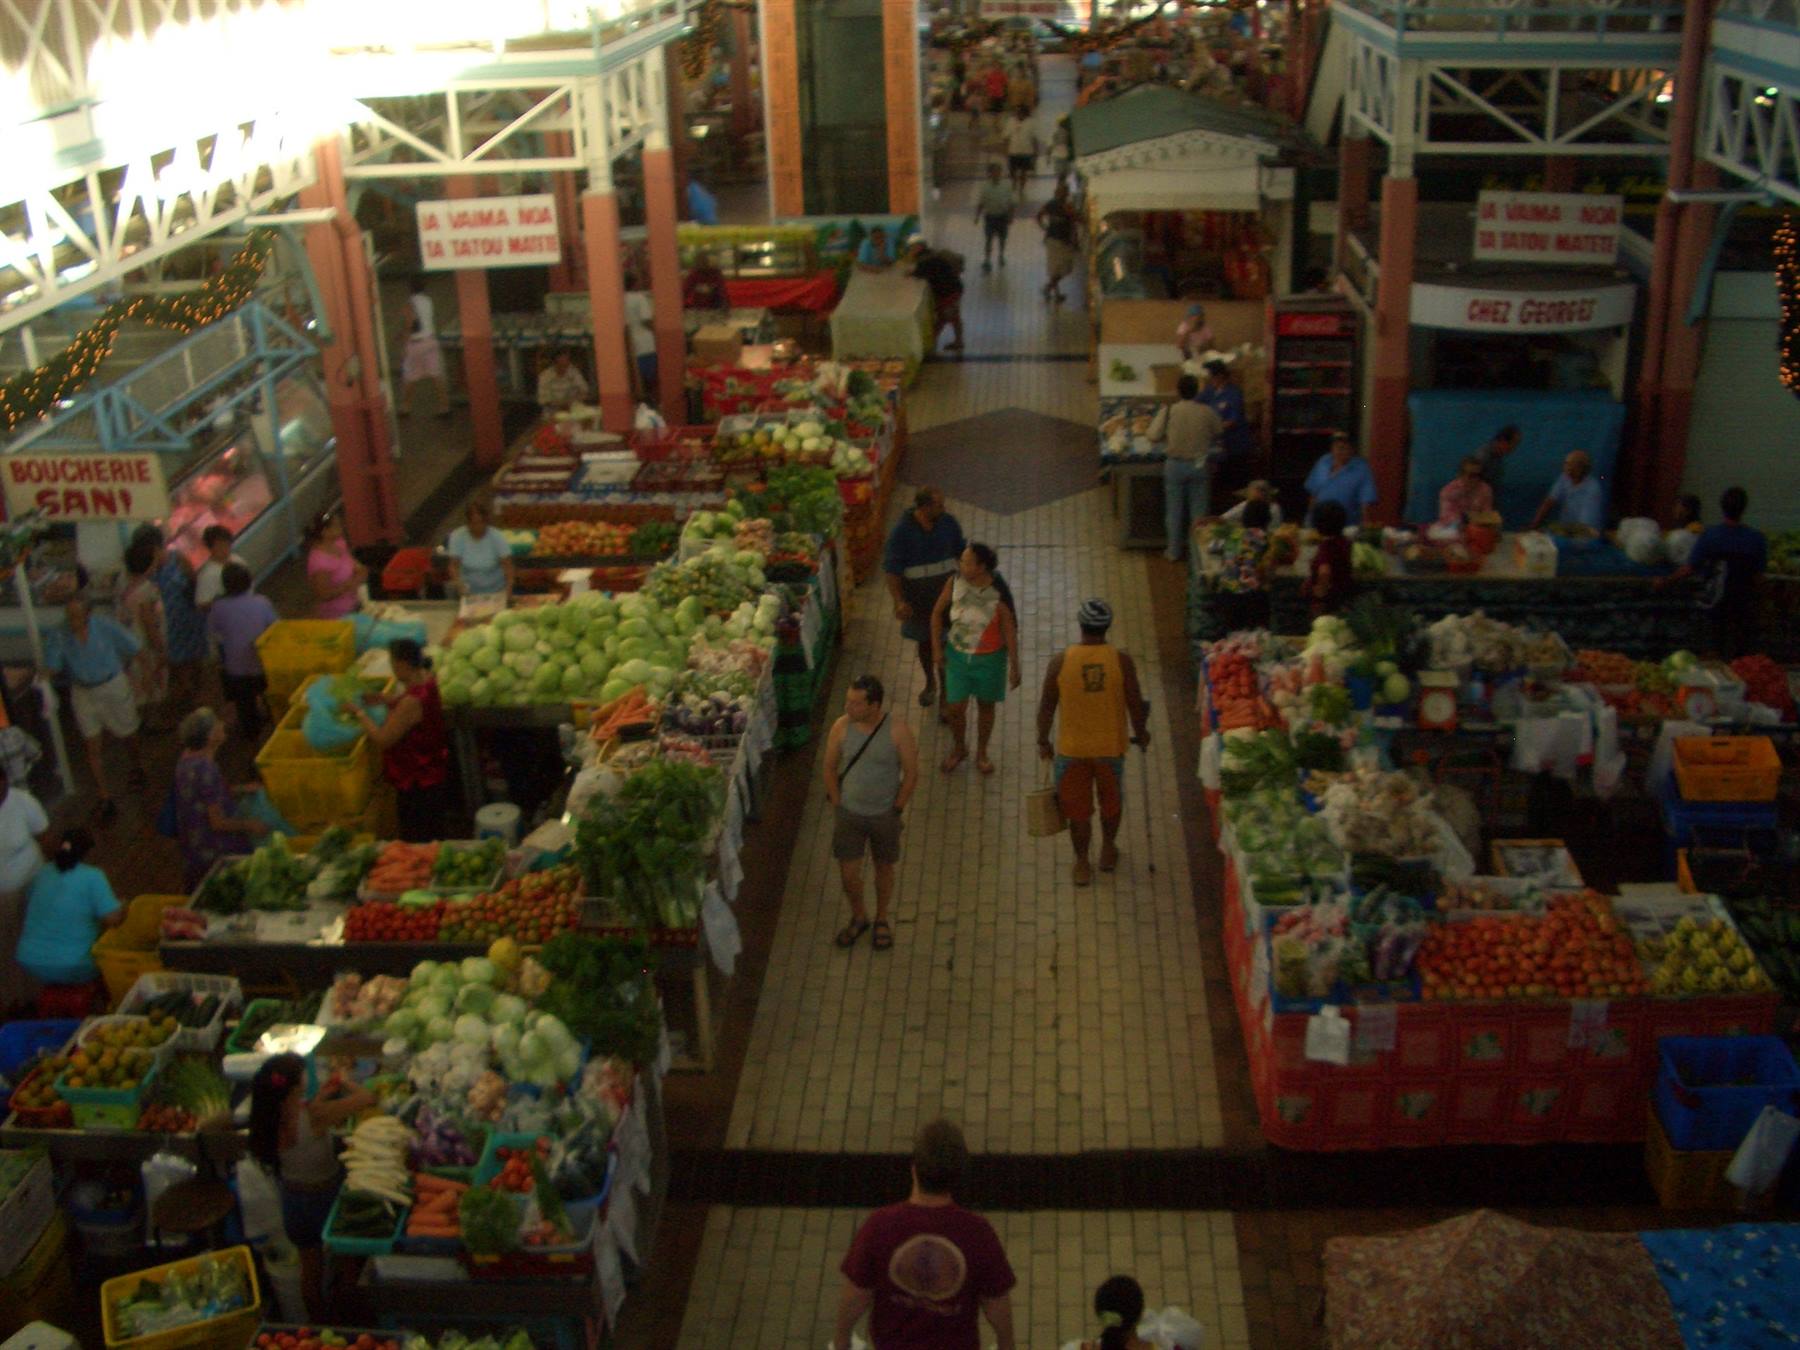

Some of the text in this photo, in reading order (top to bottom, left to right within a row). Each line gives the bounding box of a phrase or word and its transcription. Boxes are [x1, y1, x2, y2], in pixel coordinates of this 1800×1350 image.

[518, 205, 553, 225] NOA
[426, 238, 445, 258] TA
[450, 236, 504, 257] TATOU
[1502, 230, 1549, 250] TATOU
[1556, 233, 1615, 253] MATETE
[1467, 299, 1597, 325] CHEZ GEORGES
[10, 457, 152, 484] BOUCHERIE
